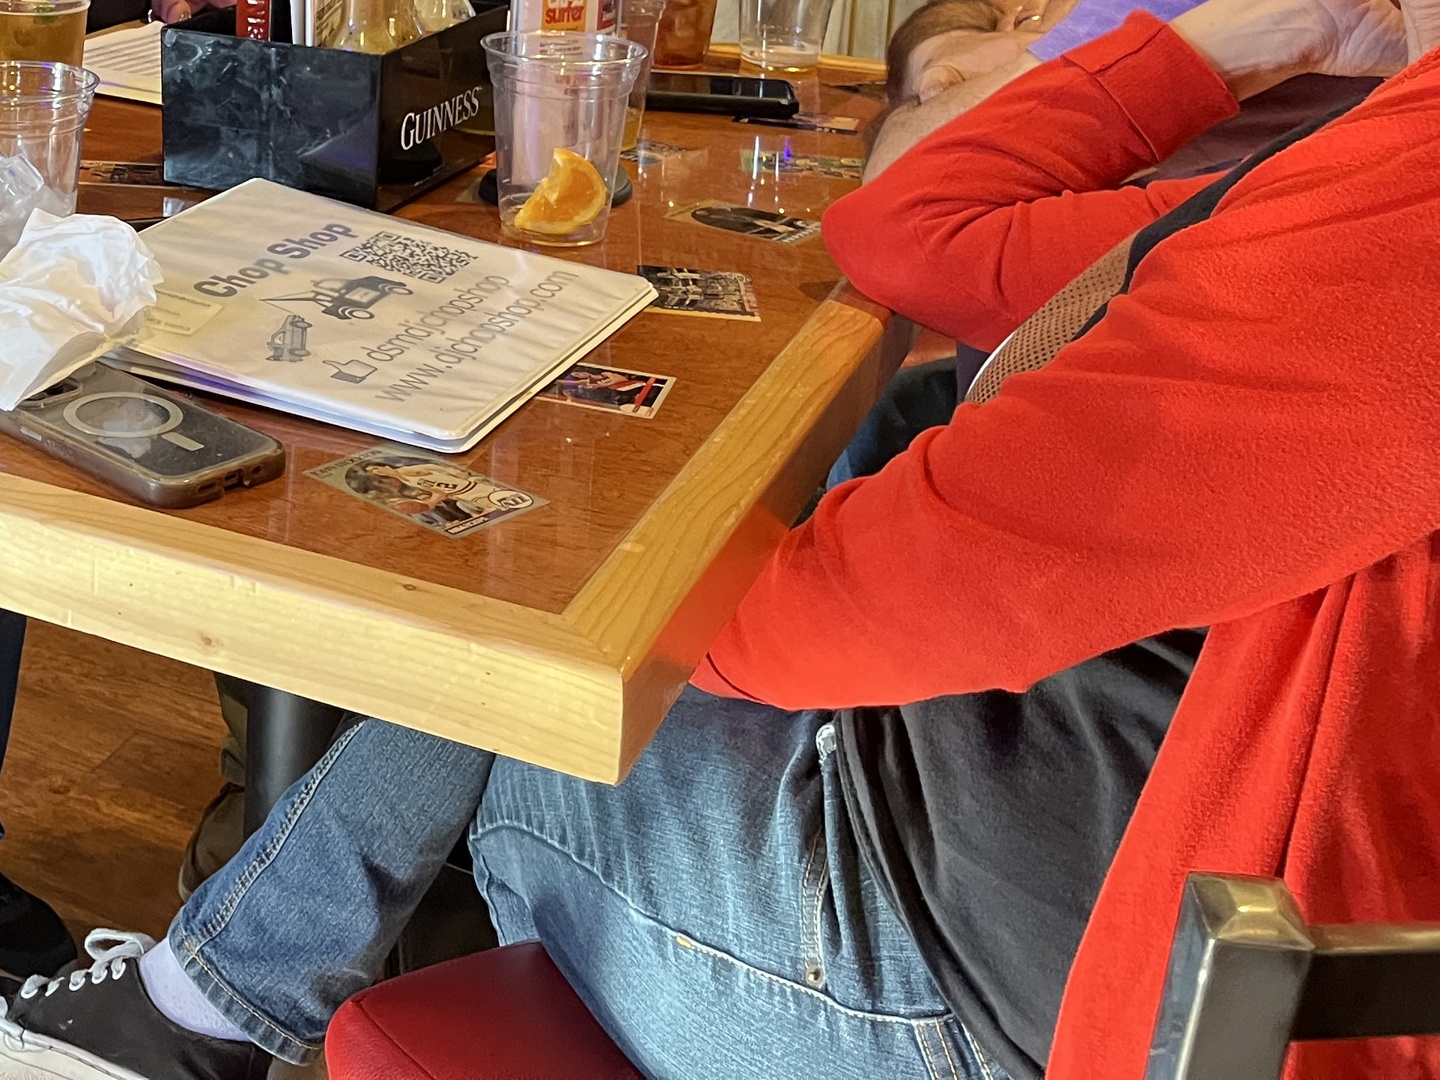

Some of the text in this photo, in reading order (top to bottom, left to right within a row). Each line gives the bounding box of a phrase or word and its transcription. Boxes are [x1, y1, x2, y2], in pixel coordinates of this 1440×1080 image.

[401, 87, 480, 150] GUINNESS
[193, 258, 290, 298] Chop
[267, 223, 358, 259] Shop
[375, 270, 579, 402] www.djchopshop.com
